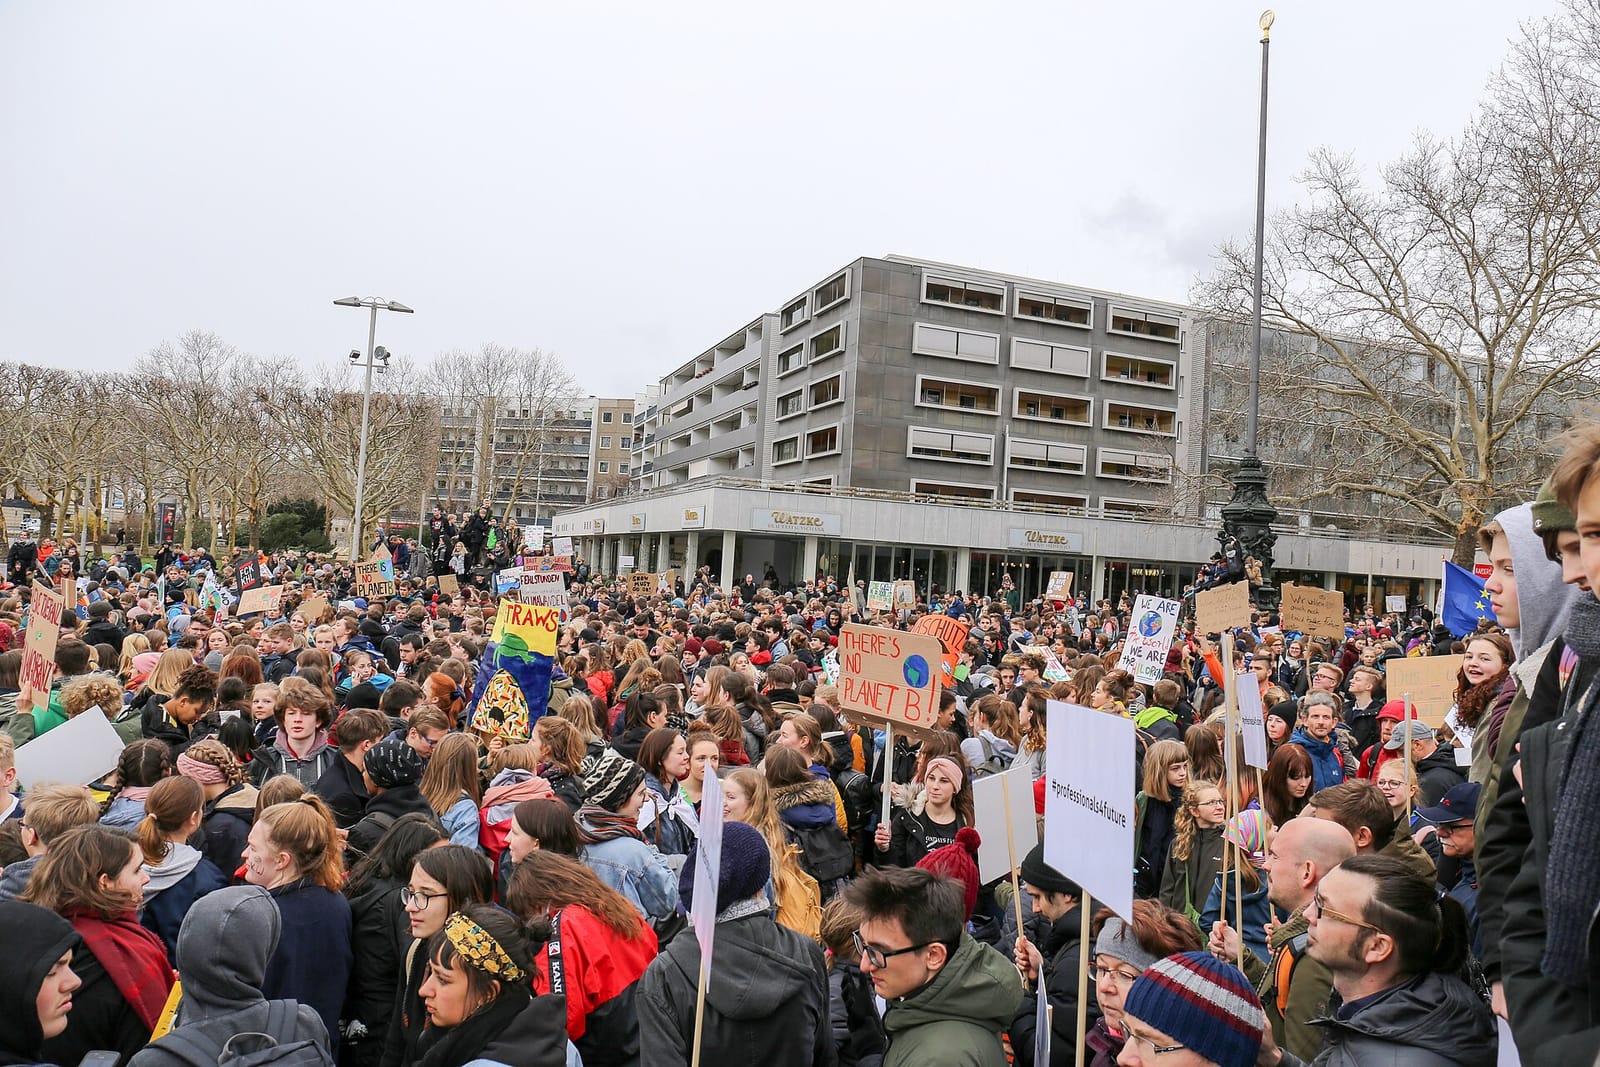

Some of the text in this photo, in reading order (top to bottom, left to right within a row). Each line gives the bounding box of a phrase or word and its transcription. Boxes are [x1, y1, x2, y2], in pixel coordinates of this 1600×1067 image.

[357, 562, 387, 574] THERE IS
[362, 574, 372, 584] NO
[520, 574, 560, 585] FEHLSTUNDEN
[359, 582, 388, 597] PLANET
[521, 594, 566, 607] KLIMAWANDEL
[1141, 599, 1177, 616] WE ARE
[842, 631, 900, 658] THERE'S
[845, 652, 861, 674] NO
[1123, 655, 1136, 667] the
[1130, 645, 1166, 664] WE ARE
[844, 677, 899, 714] PLANET
[1052, 779, 1126, 828] #professionals4future
[552, 961, 562, 993] KANI
